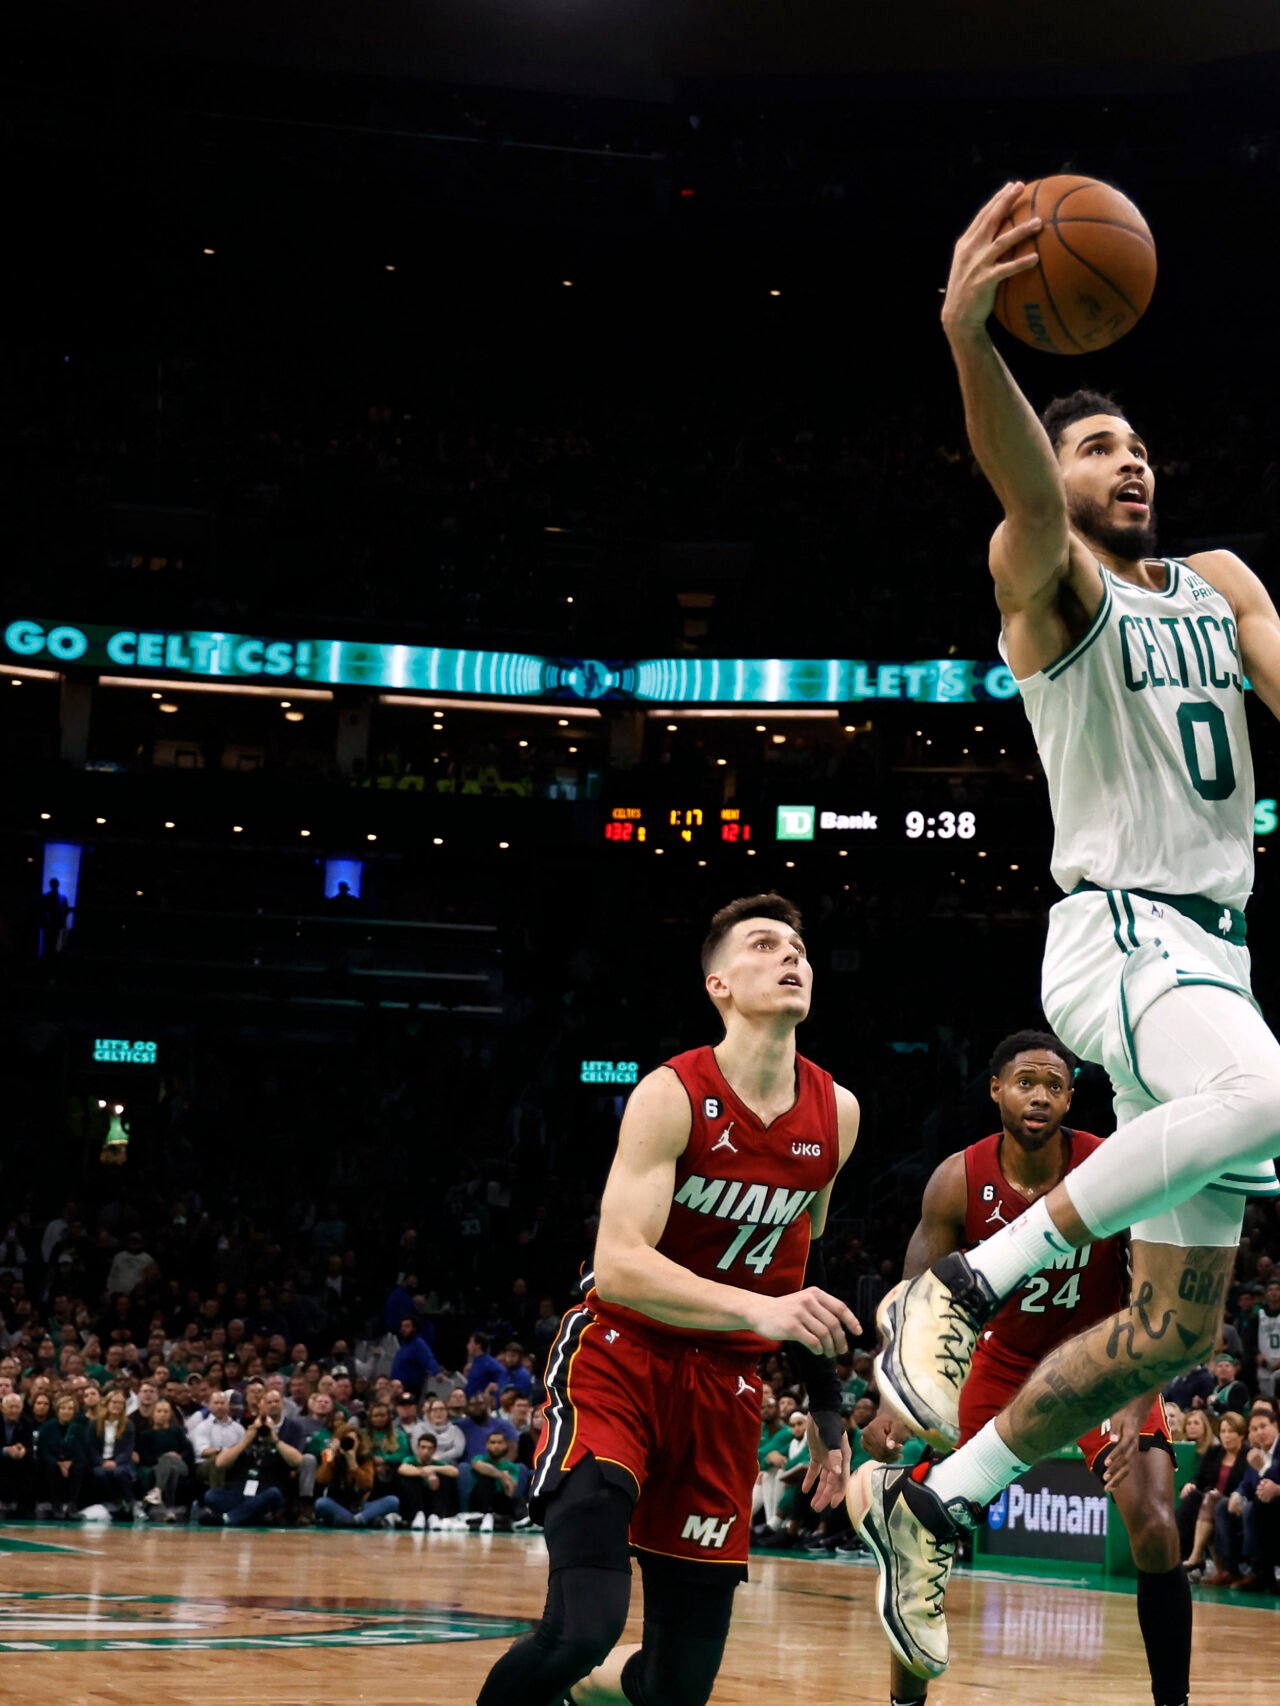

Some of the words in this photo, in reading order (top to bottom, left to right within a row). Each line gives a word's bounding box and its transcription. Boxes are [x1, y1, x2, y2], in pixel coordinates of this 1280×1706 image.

[5, 620, 87, 660] GO
[106, 631, 312, 677] CELTICS!
[1118, 613, 1243, 693] CELTICS
[853, 664, 967, 698] LET'S
[983, 665, 1020, 699] G
[1176, 701, 1236, 801] 0
[780, 811, 812, 835] TD
[820, 810, 878, 830] Bank
[905, 810, 976, 839] 9:38
[704, 1098, 719, 1119] 6
[673, 1174, 818, 1226] MIAMI
[982, 1185, 995, 1201] 6
[716, 1224, 785, 1275] 14
[1020, 1272, 1081, 1313] 24
[1007, 1483, 1109, 1537] Putnam
